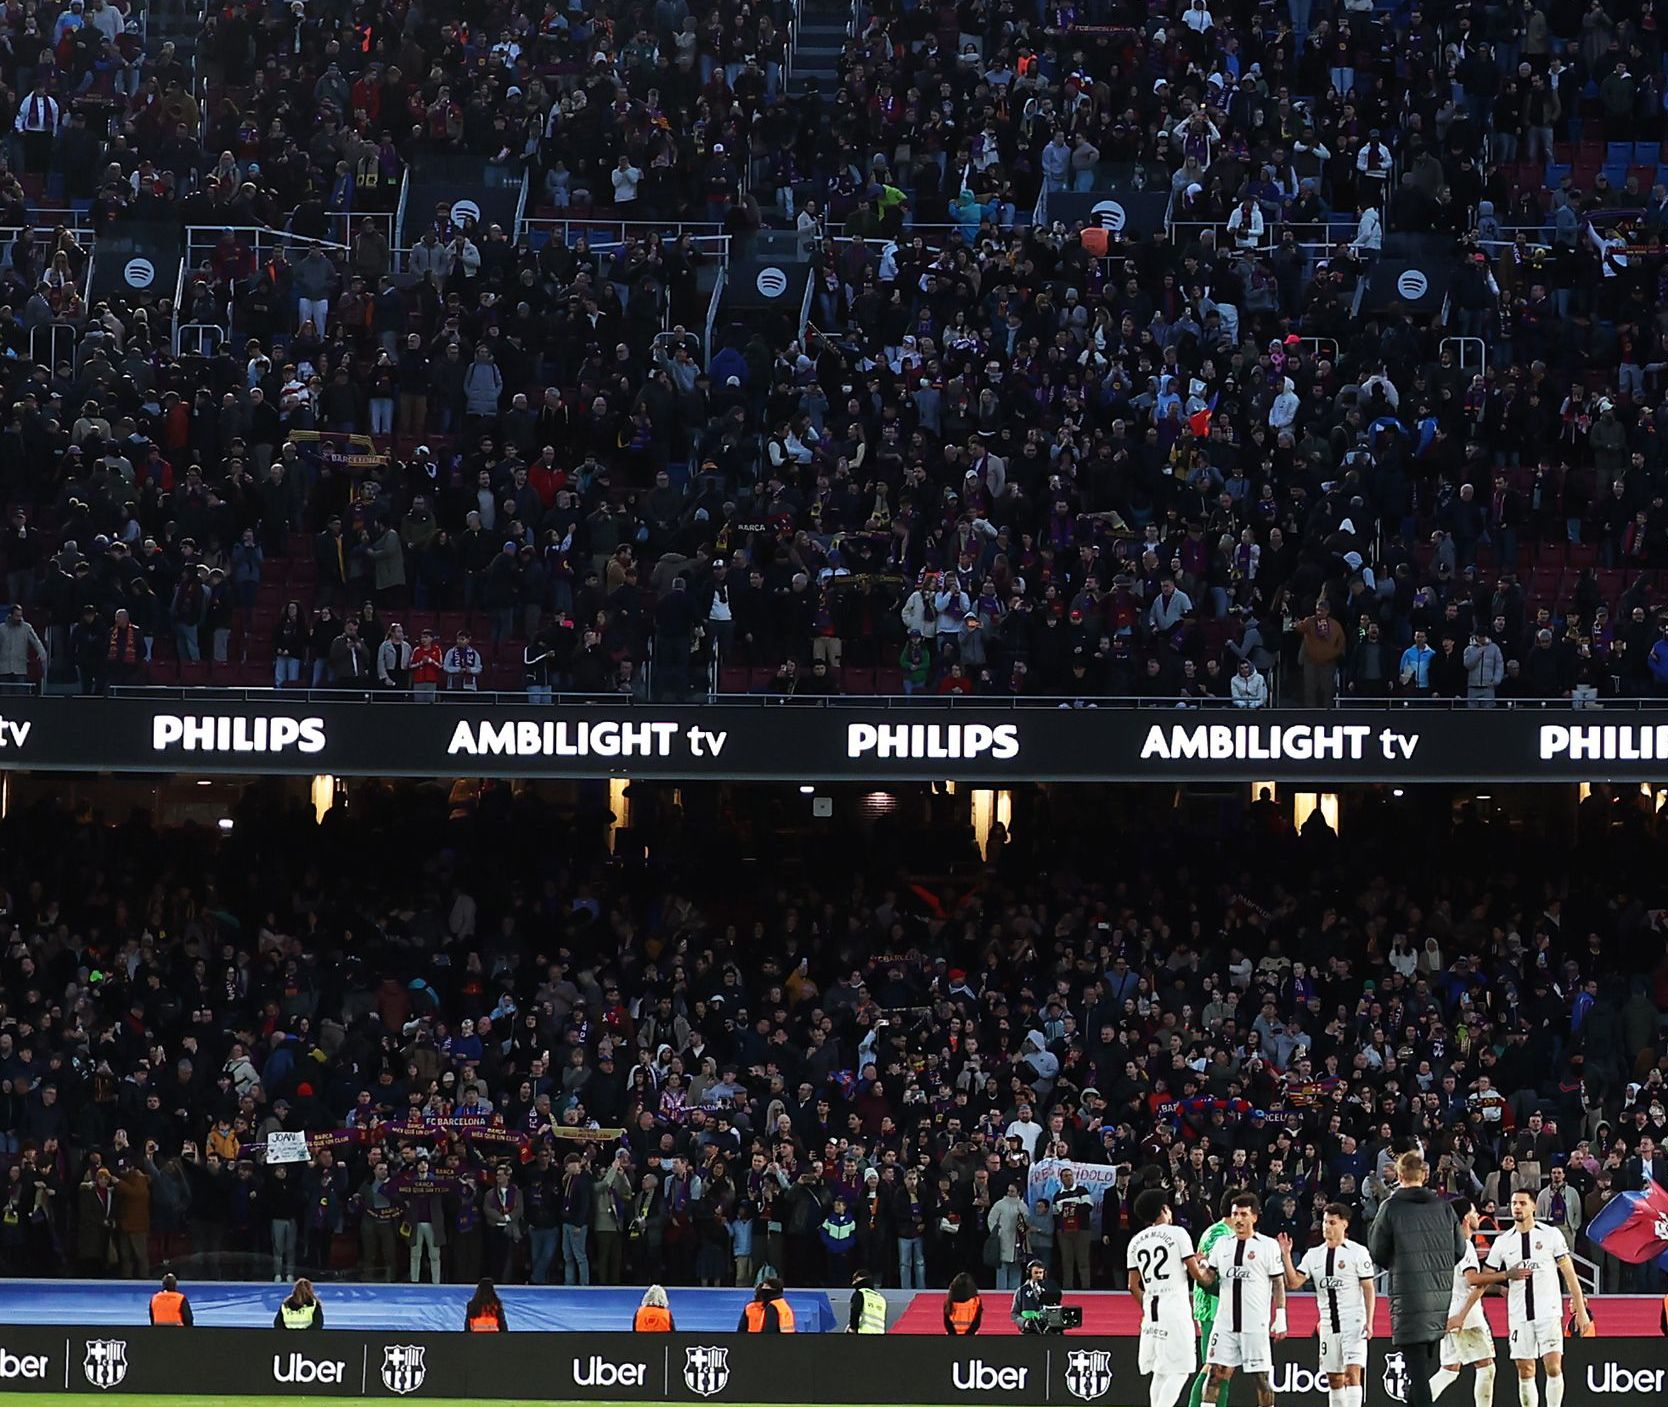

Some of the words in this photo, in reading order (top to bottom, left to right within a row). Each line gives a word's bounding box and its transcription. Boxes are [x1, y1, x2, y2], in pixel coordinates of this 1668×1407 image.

[154, 716, 326, 753] PHILIPS
[448, 721, 679, 756] AMBILIGHT
[687, 726, 727, 757] tv
[848, 724, 1019, 759] PHILIPS
[1141, 725, 1371, 760] AMBILIGHT
[1380, 729, 1419, 759] tv
[426, 1118, 436, 1126] FC
[437, 1117, 486, 1126] BARCELONA
[271, 1133, 296, 1142] JOAN
[1137, 1245, 1169, 1283] 22
[1511, 1332, 1518, 1344] 4
[0, 1348, 48, 1378] ber
[273, 1352, 345, 1384] Uber
[573, 1356, 646, 1386] Uber
[953, 1360, 1028, 1390] Uber
[1269, 1362, 1330, 1393] Ube
[1587, 1362, 1665, 1393] Uber
